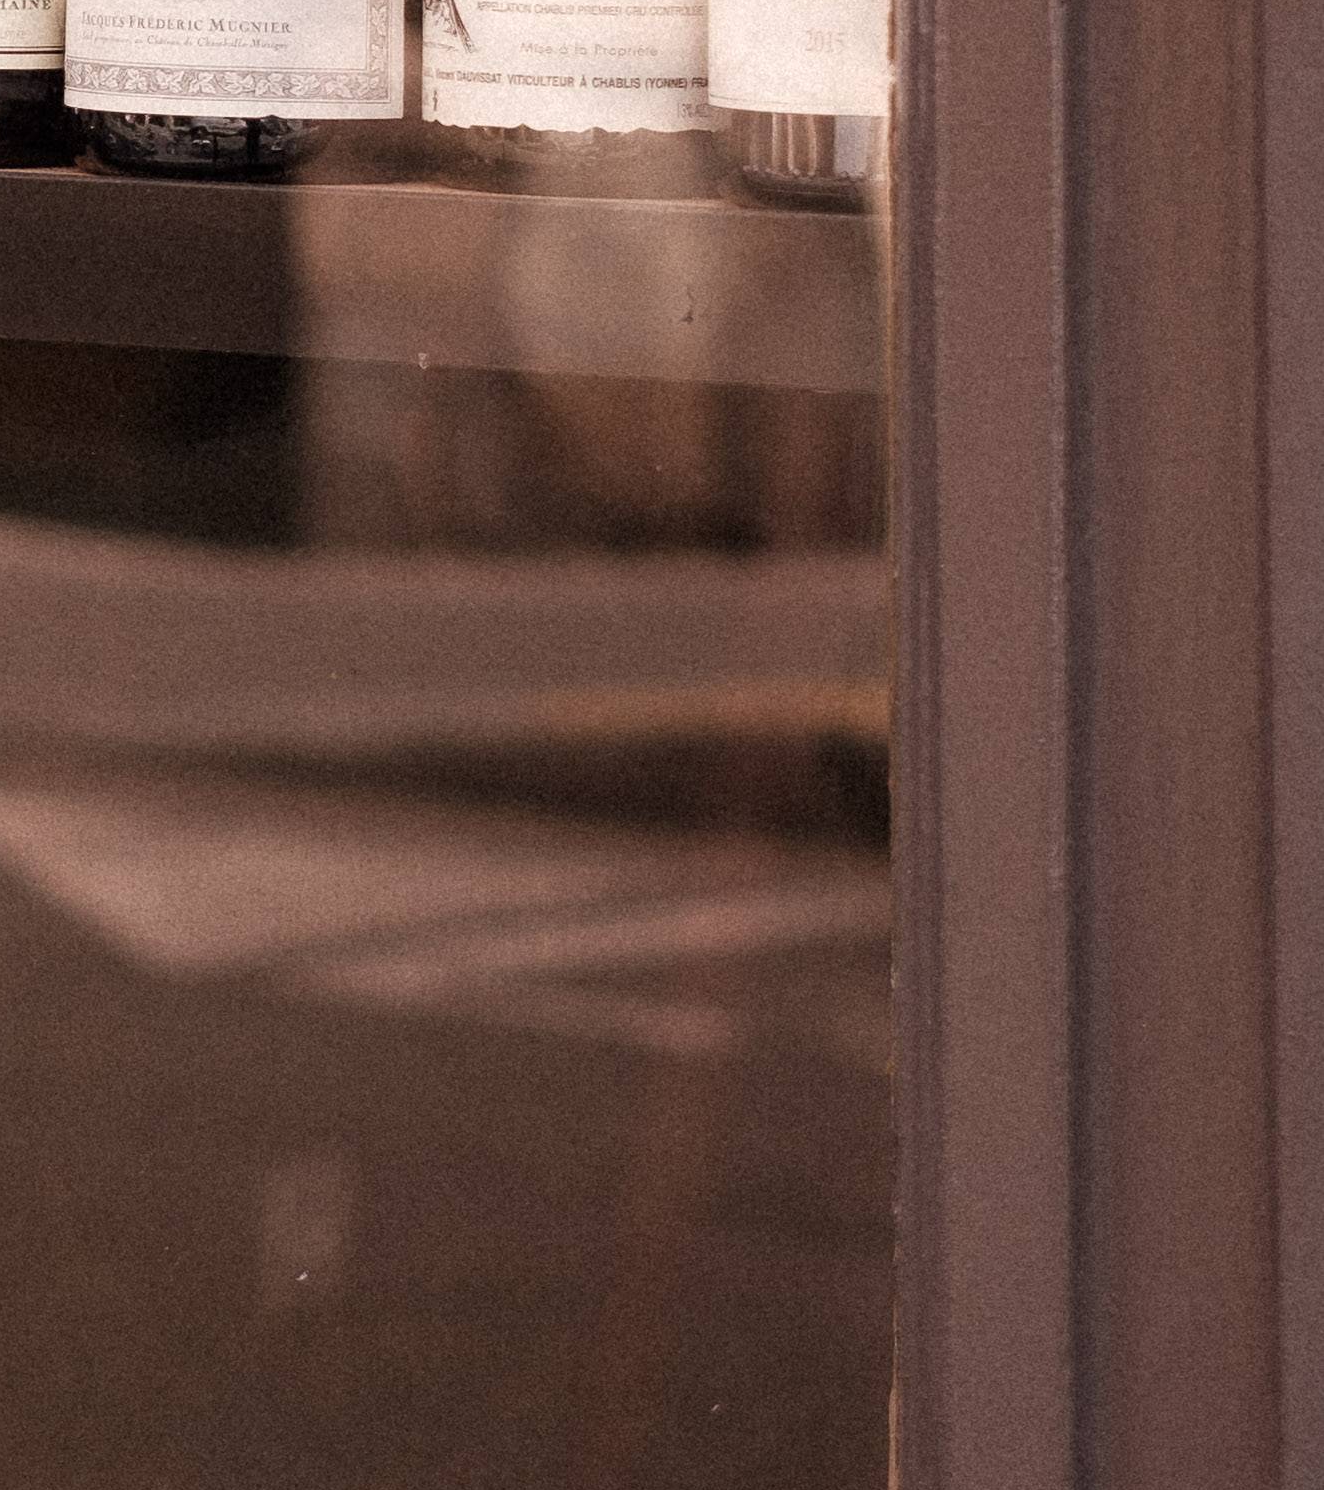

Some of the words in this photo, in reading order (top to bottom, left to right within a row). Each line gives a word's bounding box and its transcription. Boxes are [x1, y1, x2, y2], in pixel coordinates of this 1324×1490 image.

[534, 3, 574, 16] CHABLIS
[81, 11, 125, 28] JACQUES
[209, 18, 293, 34] MUGNIER
[520, 42, 553, 56] Mise
[574, 42, 590, 56] la
[508, 74, 574, 88] VITICULTEUR
[592, 76, 641, 89] CHABLIS
[645, 77, 688, 91] (YONNE)
